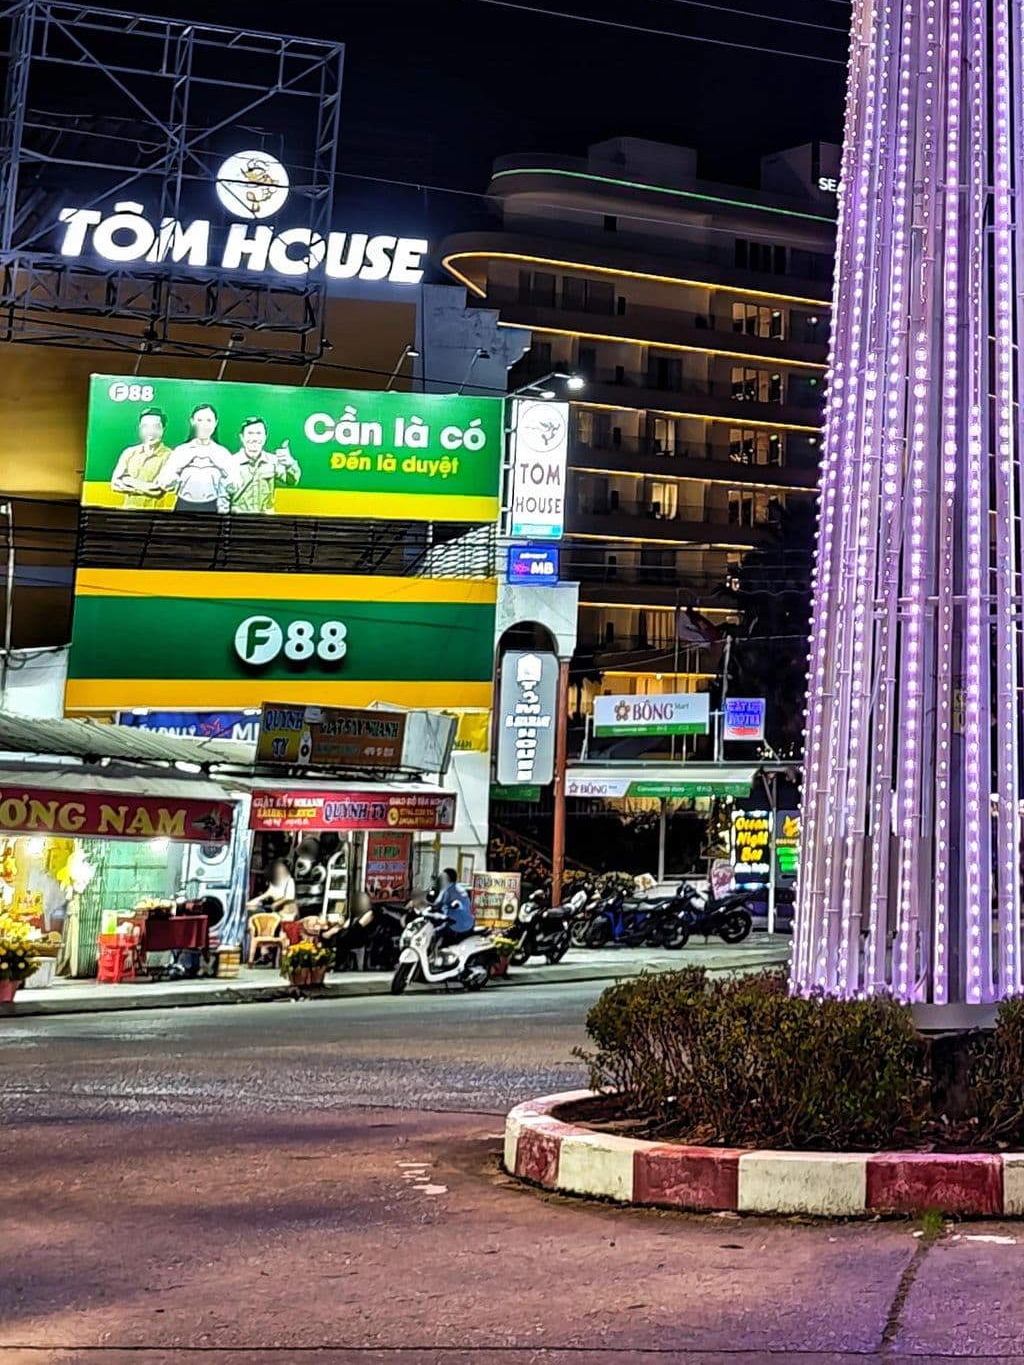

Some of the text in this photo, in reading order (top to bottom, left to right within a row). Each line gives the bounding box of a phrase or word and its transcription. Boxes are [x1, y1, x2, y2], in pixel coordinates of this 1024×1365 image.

[818, 177, 841, 193] SE
[221, 223, 429, 284] HOUSE
[109, 382, 154, 402] F88
[304, 405, 486, 451] Cần là có
[330, 449, 459, 478] Đến là duyệt
[515, 496, 561, 514] HOUSE
[530, 561, 554, 575] MB
[235, 615, 347, 665] F88
[633, 699, 674, 721] BÔNG
[0, 792, 187, 836] ƠNG NAM
